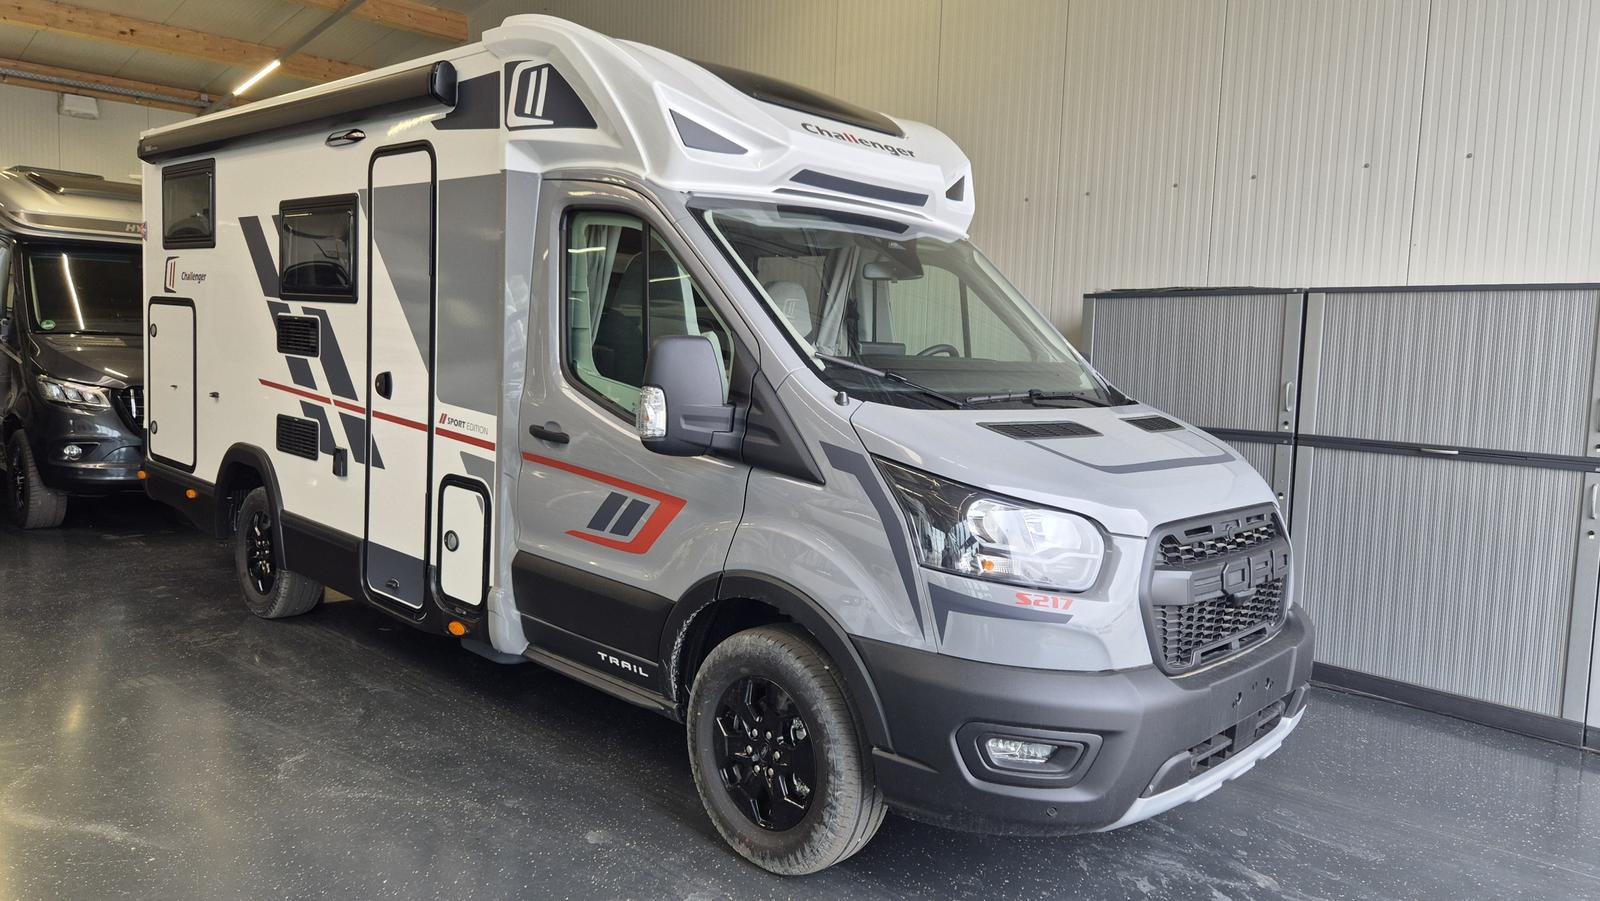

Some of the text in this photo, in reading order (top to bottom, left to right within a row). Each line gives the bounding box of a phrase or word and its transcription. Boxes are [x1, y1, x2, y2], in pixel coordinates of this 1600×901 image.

[801, 122, 915, 157] Challenger
[181, 271, 206, 284] Challenger
[447, 417, 489, 435] SPORT EDITION
[1015, 592, 1074, 610] S217
[597, 651, 649, 678] TRAIL
